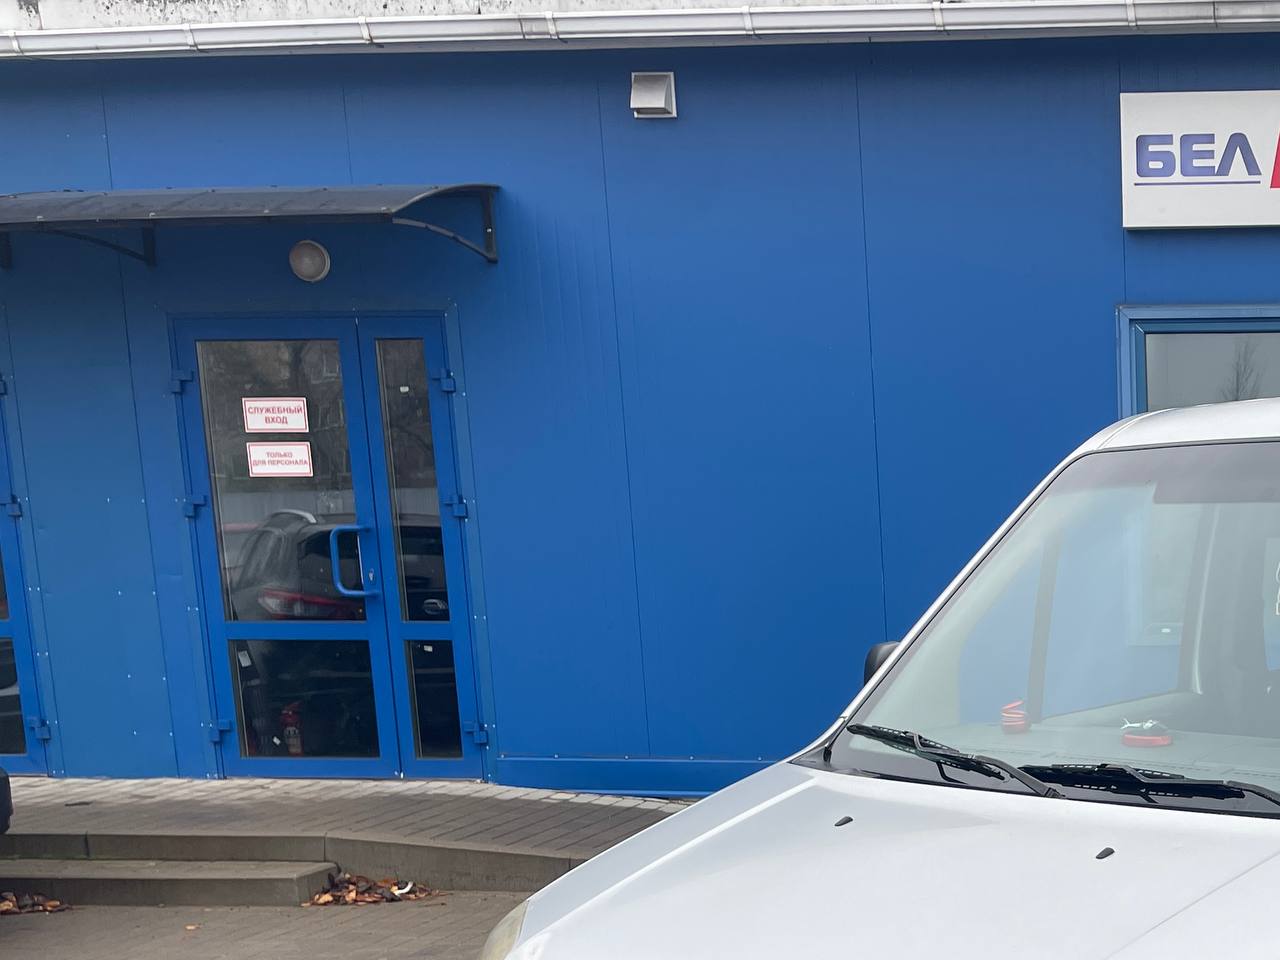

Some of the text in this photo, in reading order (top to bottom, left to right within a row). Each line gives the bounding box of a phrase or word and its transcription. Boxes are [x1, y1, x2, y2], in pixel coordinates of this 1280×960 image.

[1134, 131, 1262, 178] БЕЛ
[247, 405, 303, 414] СЛУЖЕБНЫЙ
[264, 416, 288, 424] ВХОД
